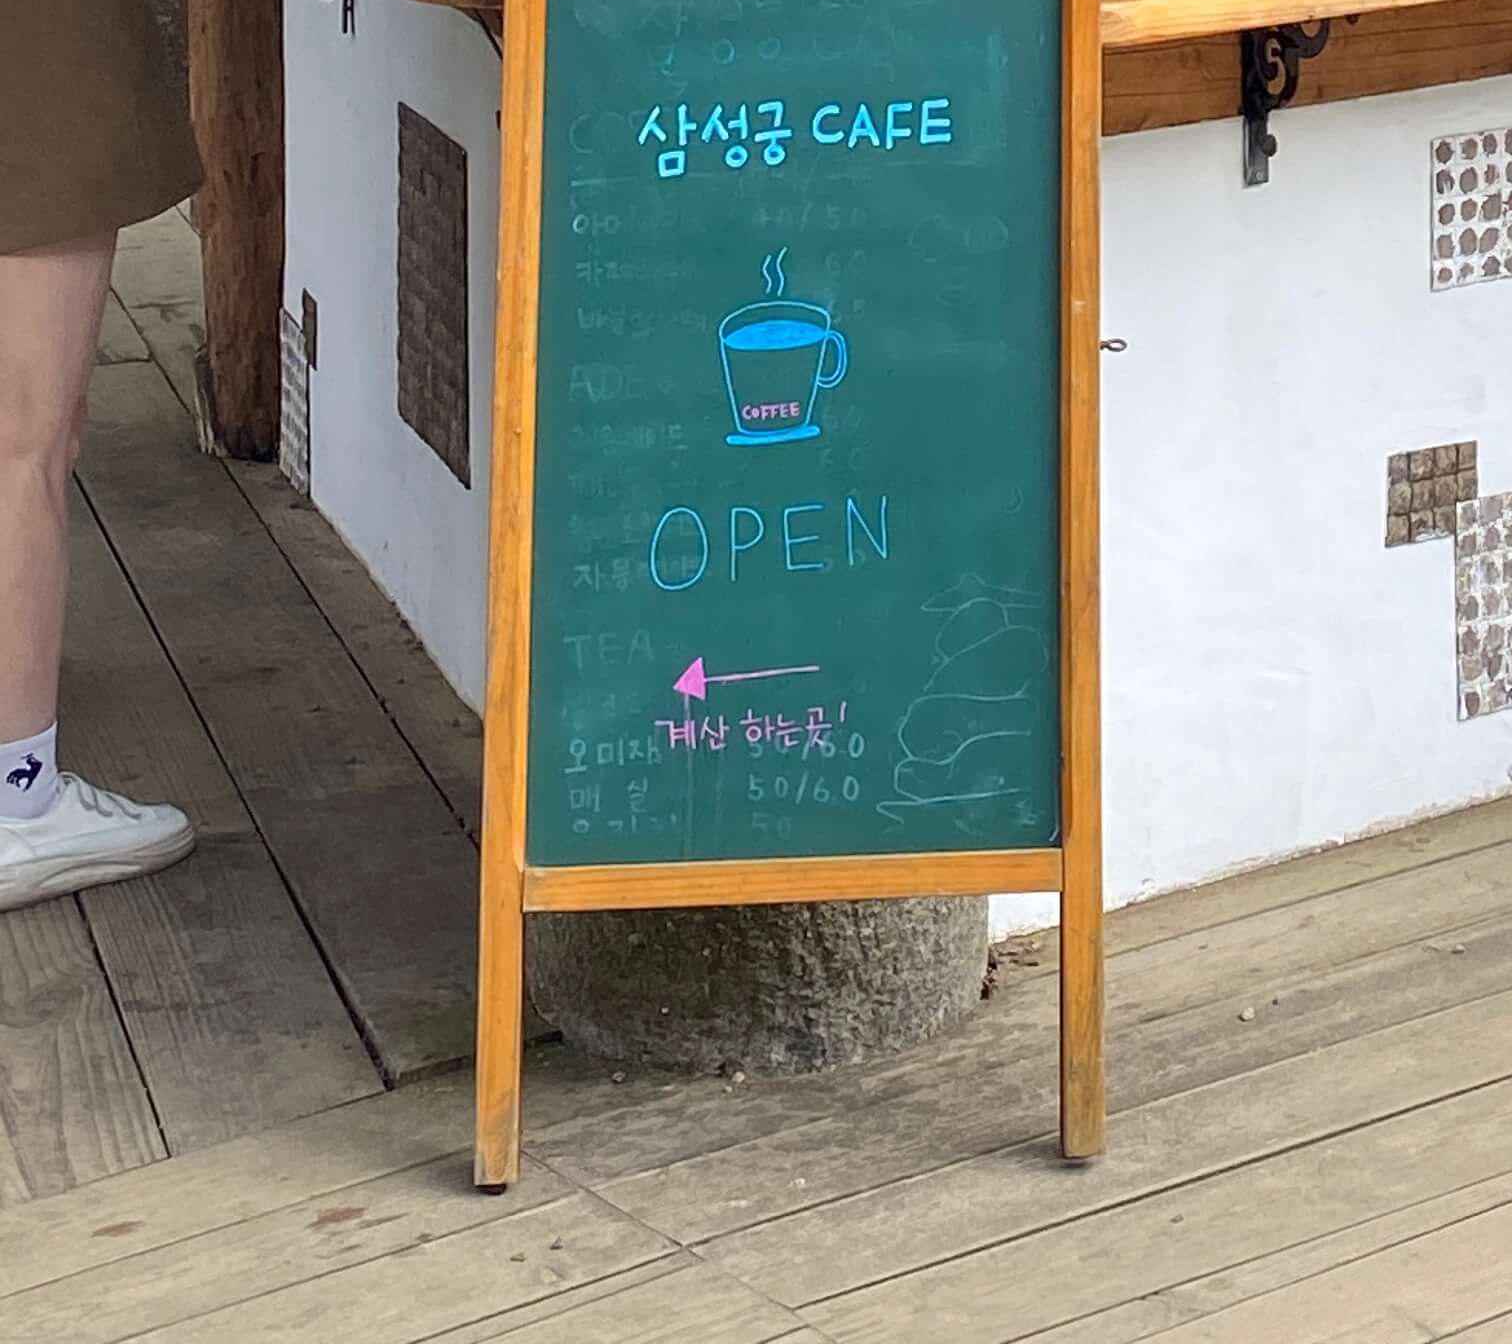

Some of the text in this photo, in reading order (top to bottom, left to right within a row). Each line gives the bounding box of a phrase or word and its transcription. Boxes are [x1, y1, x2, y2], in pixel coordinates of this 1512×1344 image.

[637, 98, 793, 178] 삼성궁
[811, 97, 952, 151] CAFE
[742, 401, 801, 422] COFFEE
[650, 495, 888, 591] OPEN
[654, 700, 848, 751] 계산 하는곳!
